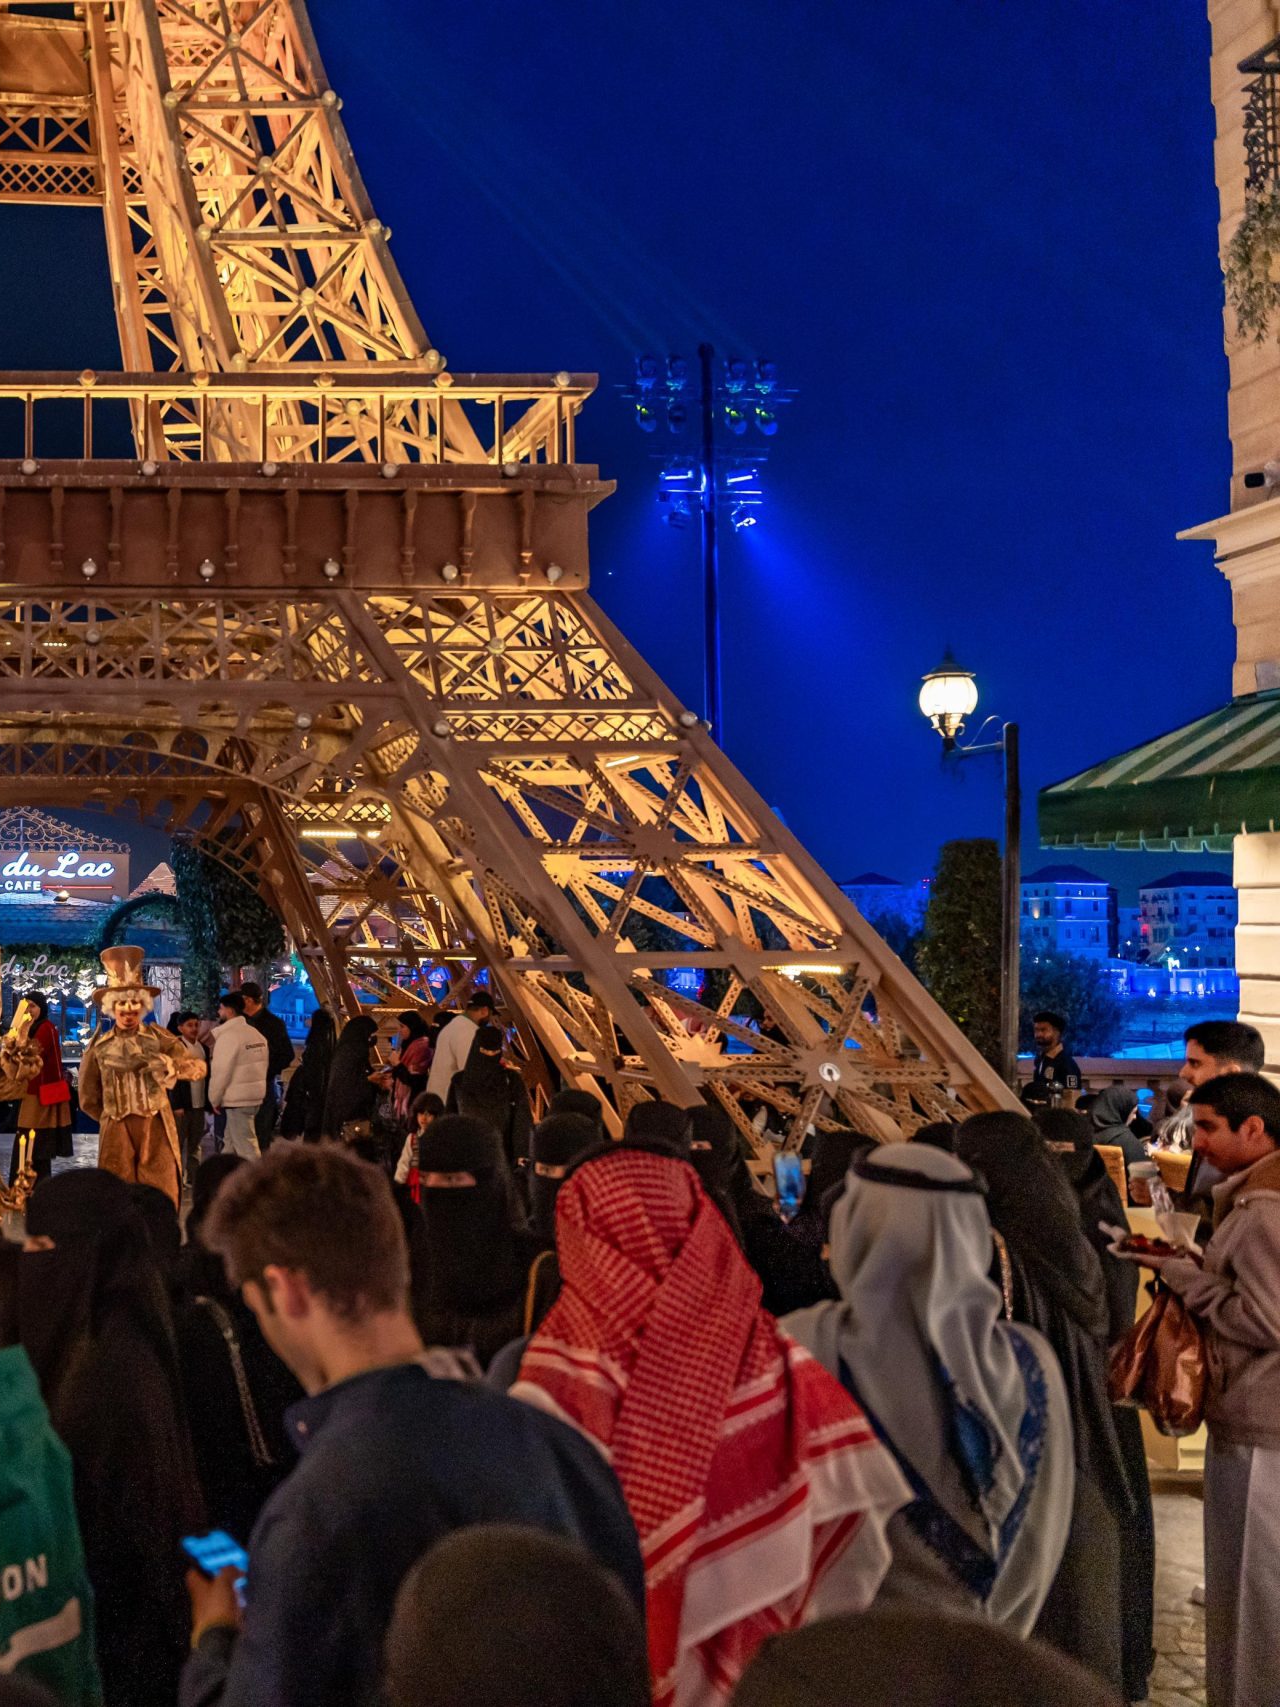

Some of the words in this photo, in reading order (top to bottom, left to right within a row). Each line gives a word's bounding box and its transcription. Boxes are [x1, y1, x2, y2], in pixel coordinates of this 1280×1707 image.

[2, 852, 45, 877] du
[47, 852, 115, 879] Lac
[4, 880, 42, 891] CAFE
[28, 954, 70, 977] Lac
